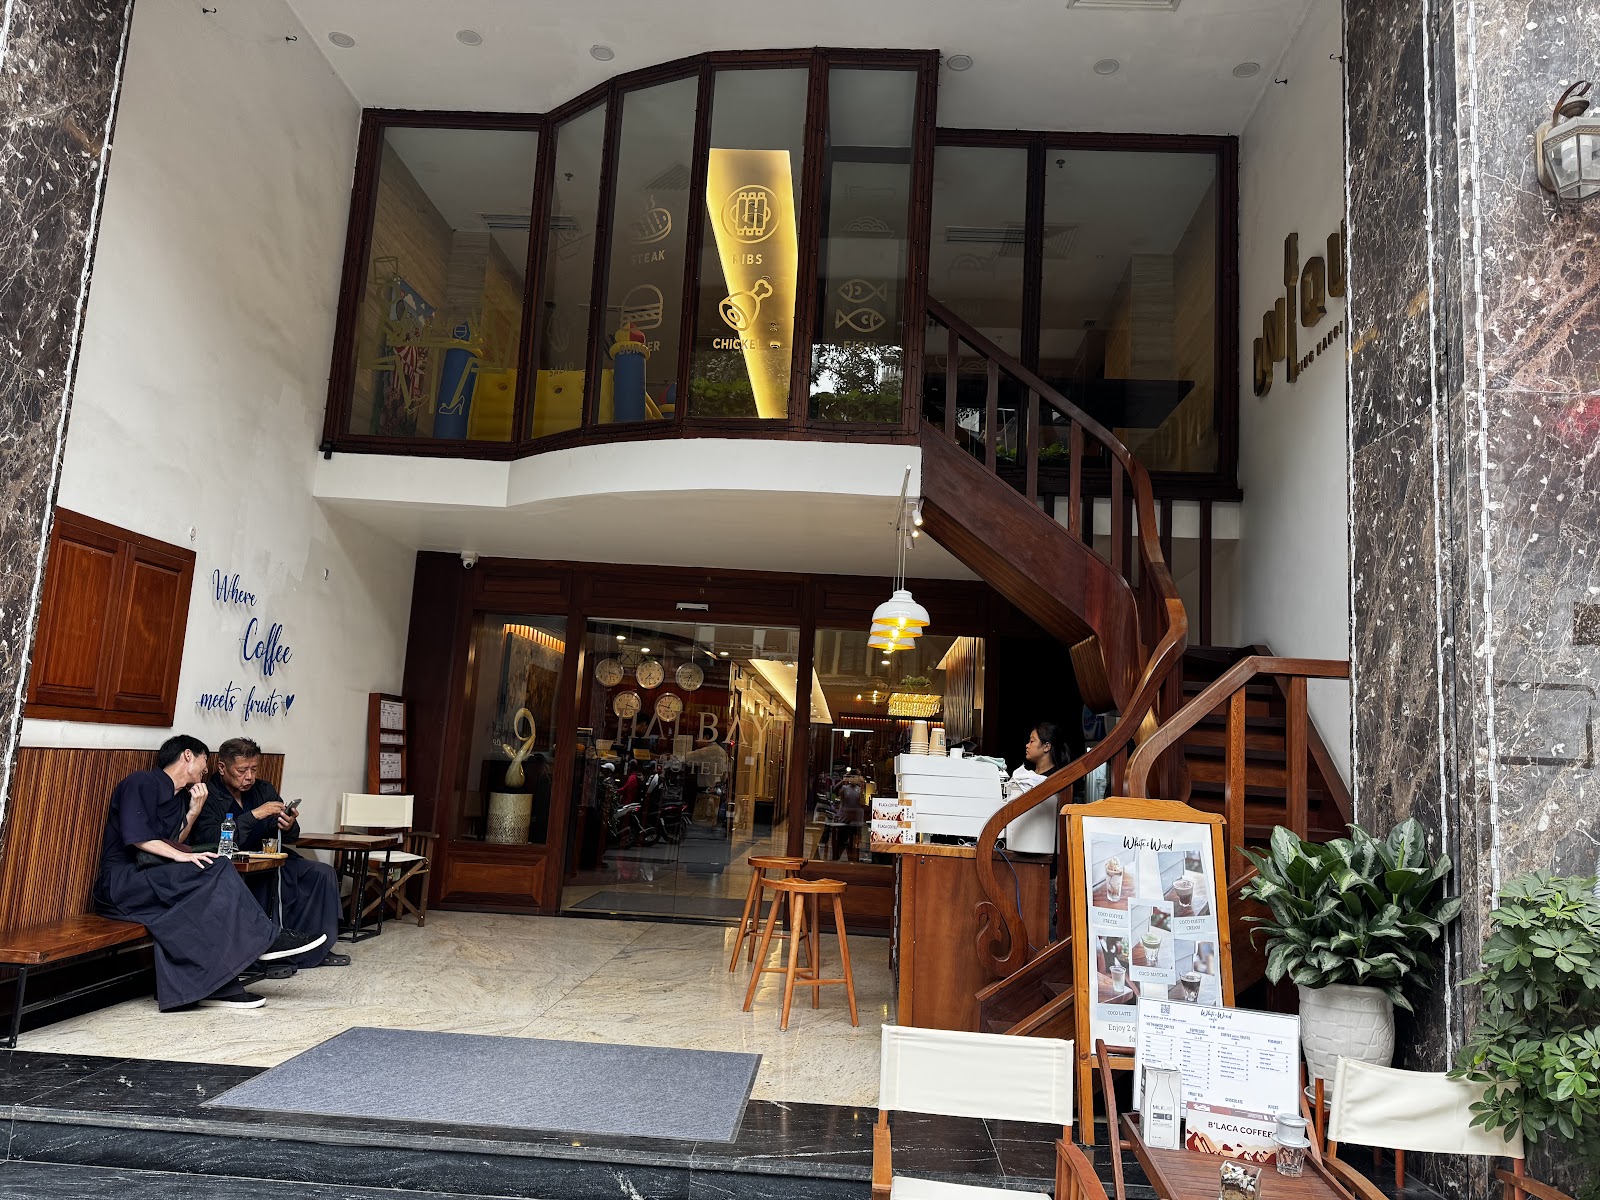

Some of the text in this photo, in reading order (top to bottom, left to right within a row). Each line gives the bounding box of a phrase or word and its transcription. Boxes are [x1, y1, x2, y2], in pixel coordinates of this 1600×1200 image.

[631, 250, 666, 265] STEAK
[732, 253, 763, 265] RIBS
[618, 340, 661, 355] BURER
[212, 568, 257, 607] Where
[243, 617, 293, 677] Coffee
[200, 681, 283, 722] meets fruits
[654, 760, 724, 777] HOTEL
[1108, 1023, 1125, 1034] Enjoy
[1207, 1121, 1273, 1139] B'LACA COFFEE
